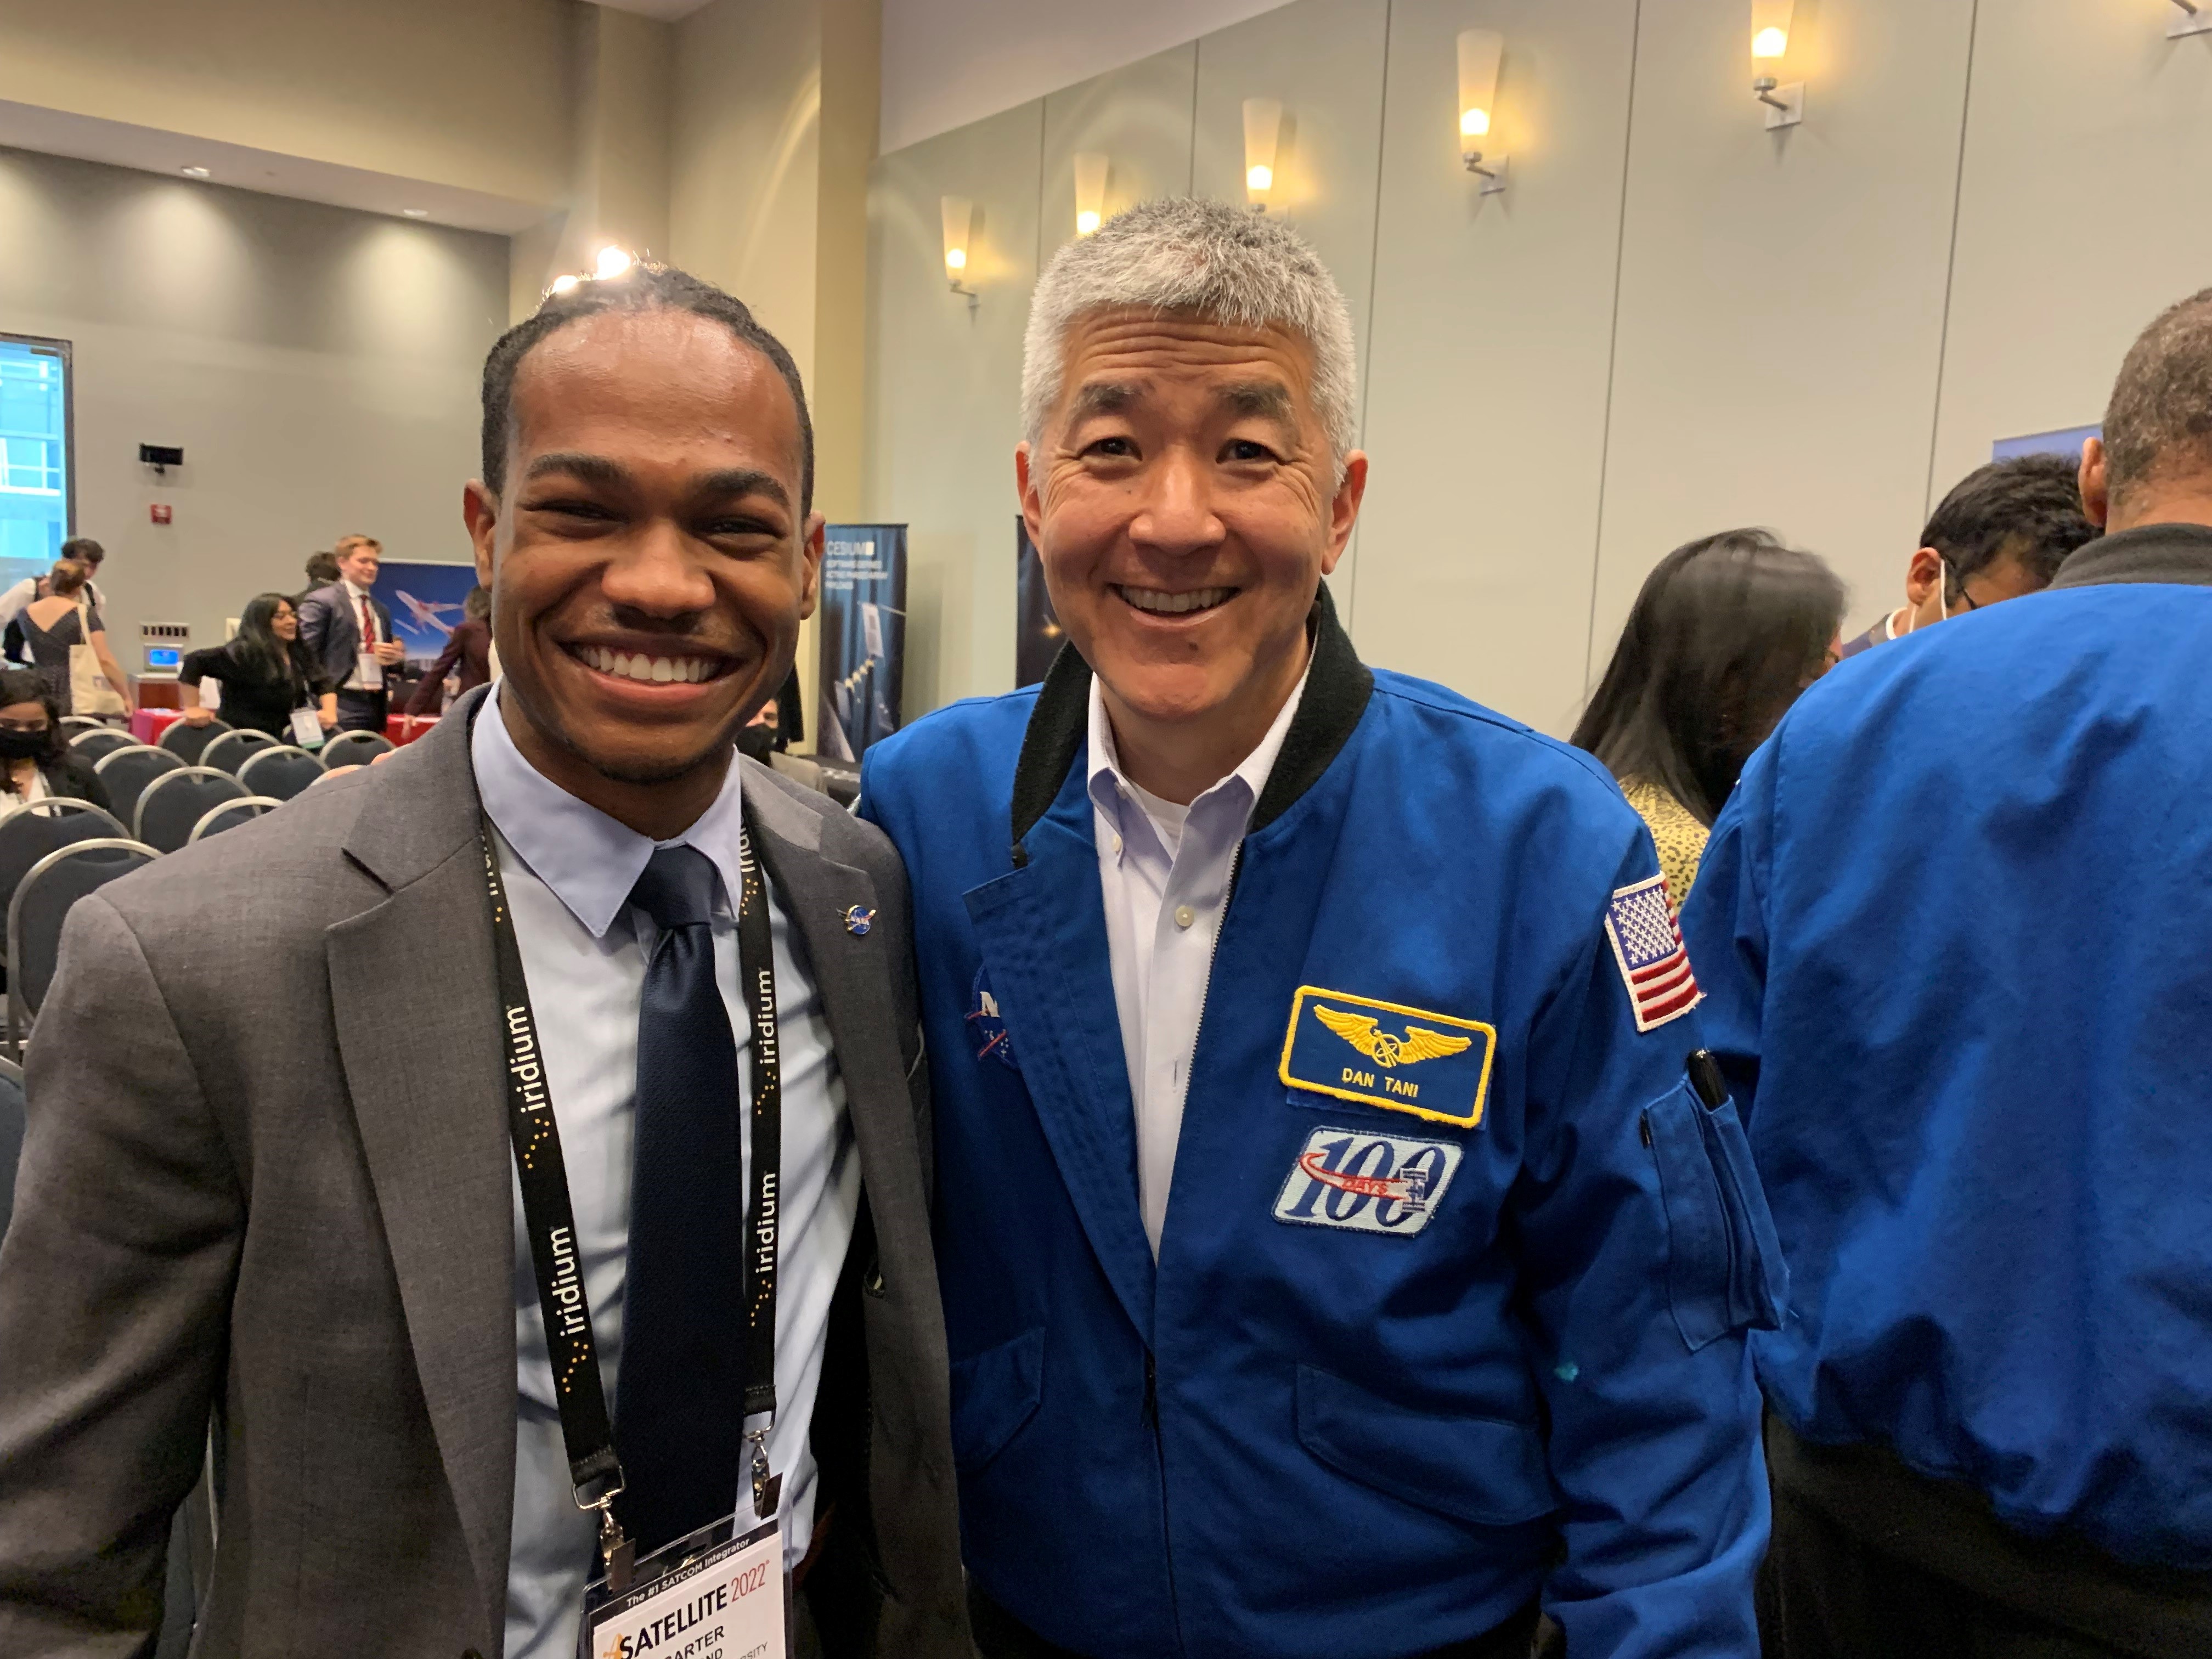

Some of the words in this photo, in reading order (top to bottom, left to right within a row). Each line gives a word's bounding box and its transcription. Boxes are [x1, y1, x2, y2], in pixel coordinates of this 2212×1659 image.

[507, 1006, 546, 1113] iridium
[758, 971, 775, 1064] iridium
[1341, 1068, 1375, 1087] DAN
[1385, 1076, 1419, 1098] TANI
[755, 1173, 776, 1273] iridium
[1284, 1137, 1446, 1227] 100
[551, 1227, 585, 1336] iridium
[627, 1593, 645, 1607] The
[647, 1584, 659, 1598] #1
[662, 1562, 703, 1590] SATCOM
[704, 1538, 750, 1568] Integrator
[619, 1583, 727, 1659] SATELLITE
